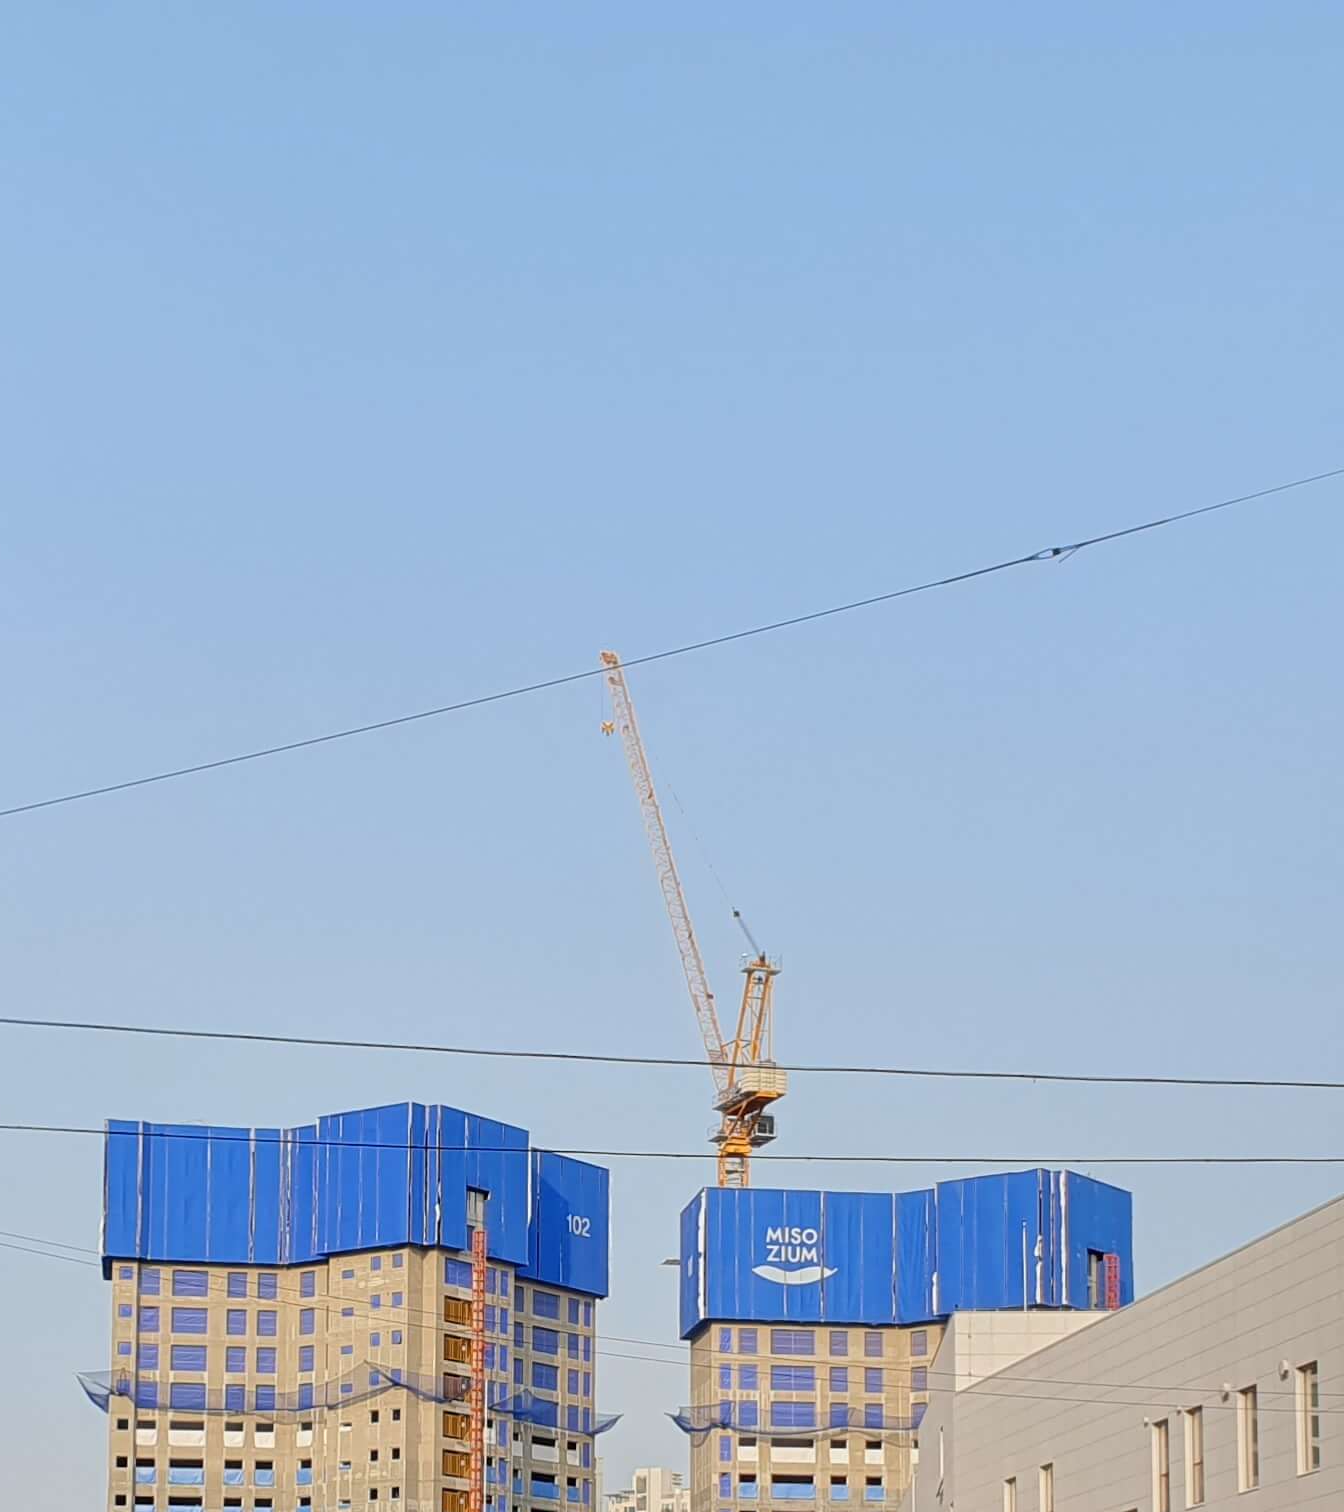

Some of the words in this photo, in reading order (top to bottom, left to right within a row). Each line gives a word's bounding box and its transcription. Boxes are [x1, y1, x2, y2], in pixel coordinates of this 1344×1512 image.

[566, 1213, 591, 1237] 102
[766, 1226, 818, 1245] MISO
[766, 1246, 818, 1263] ZIUM
